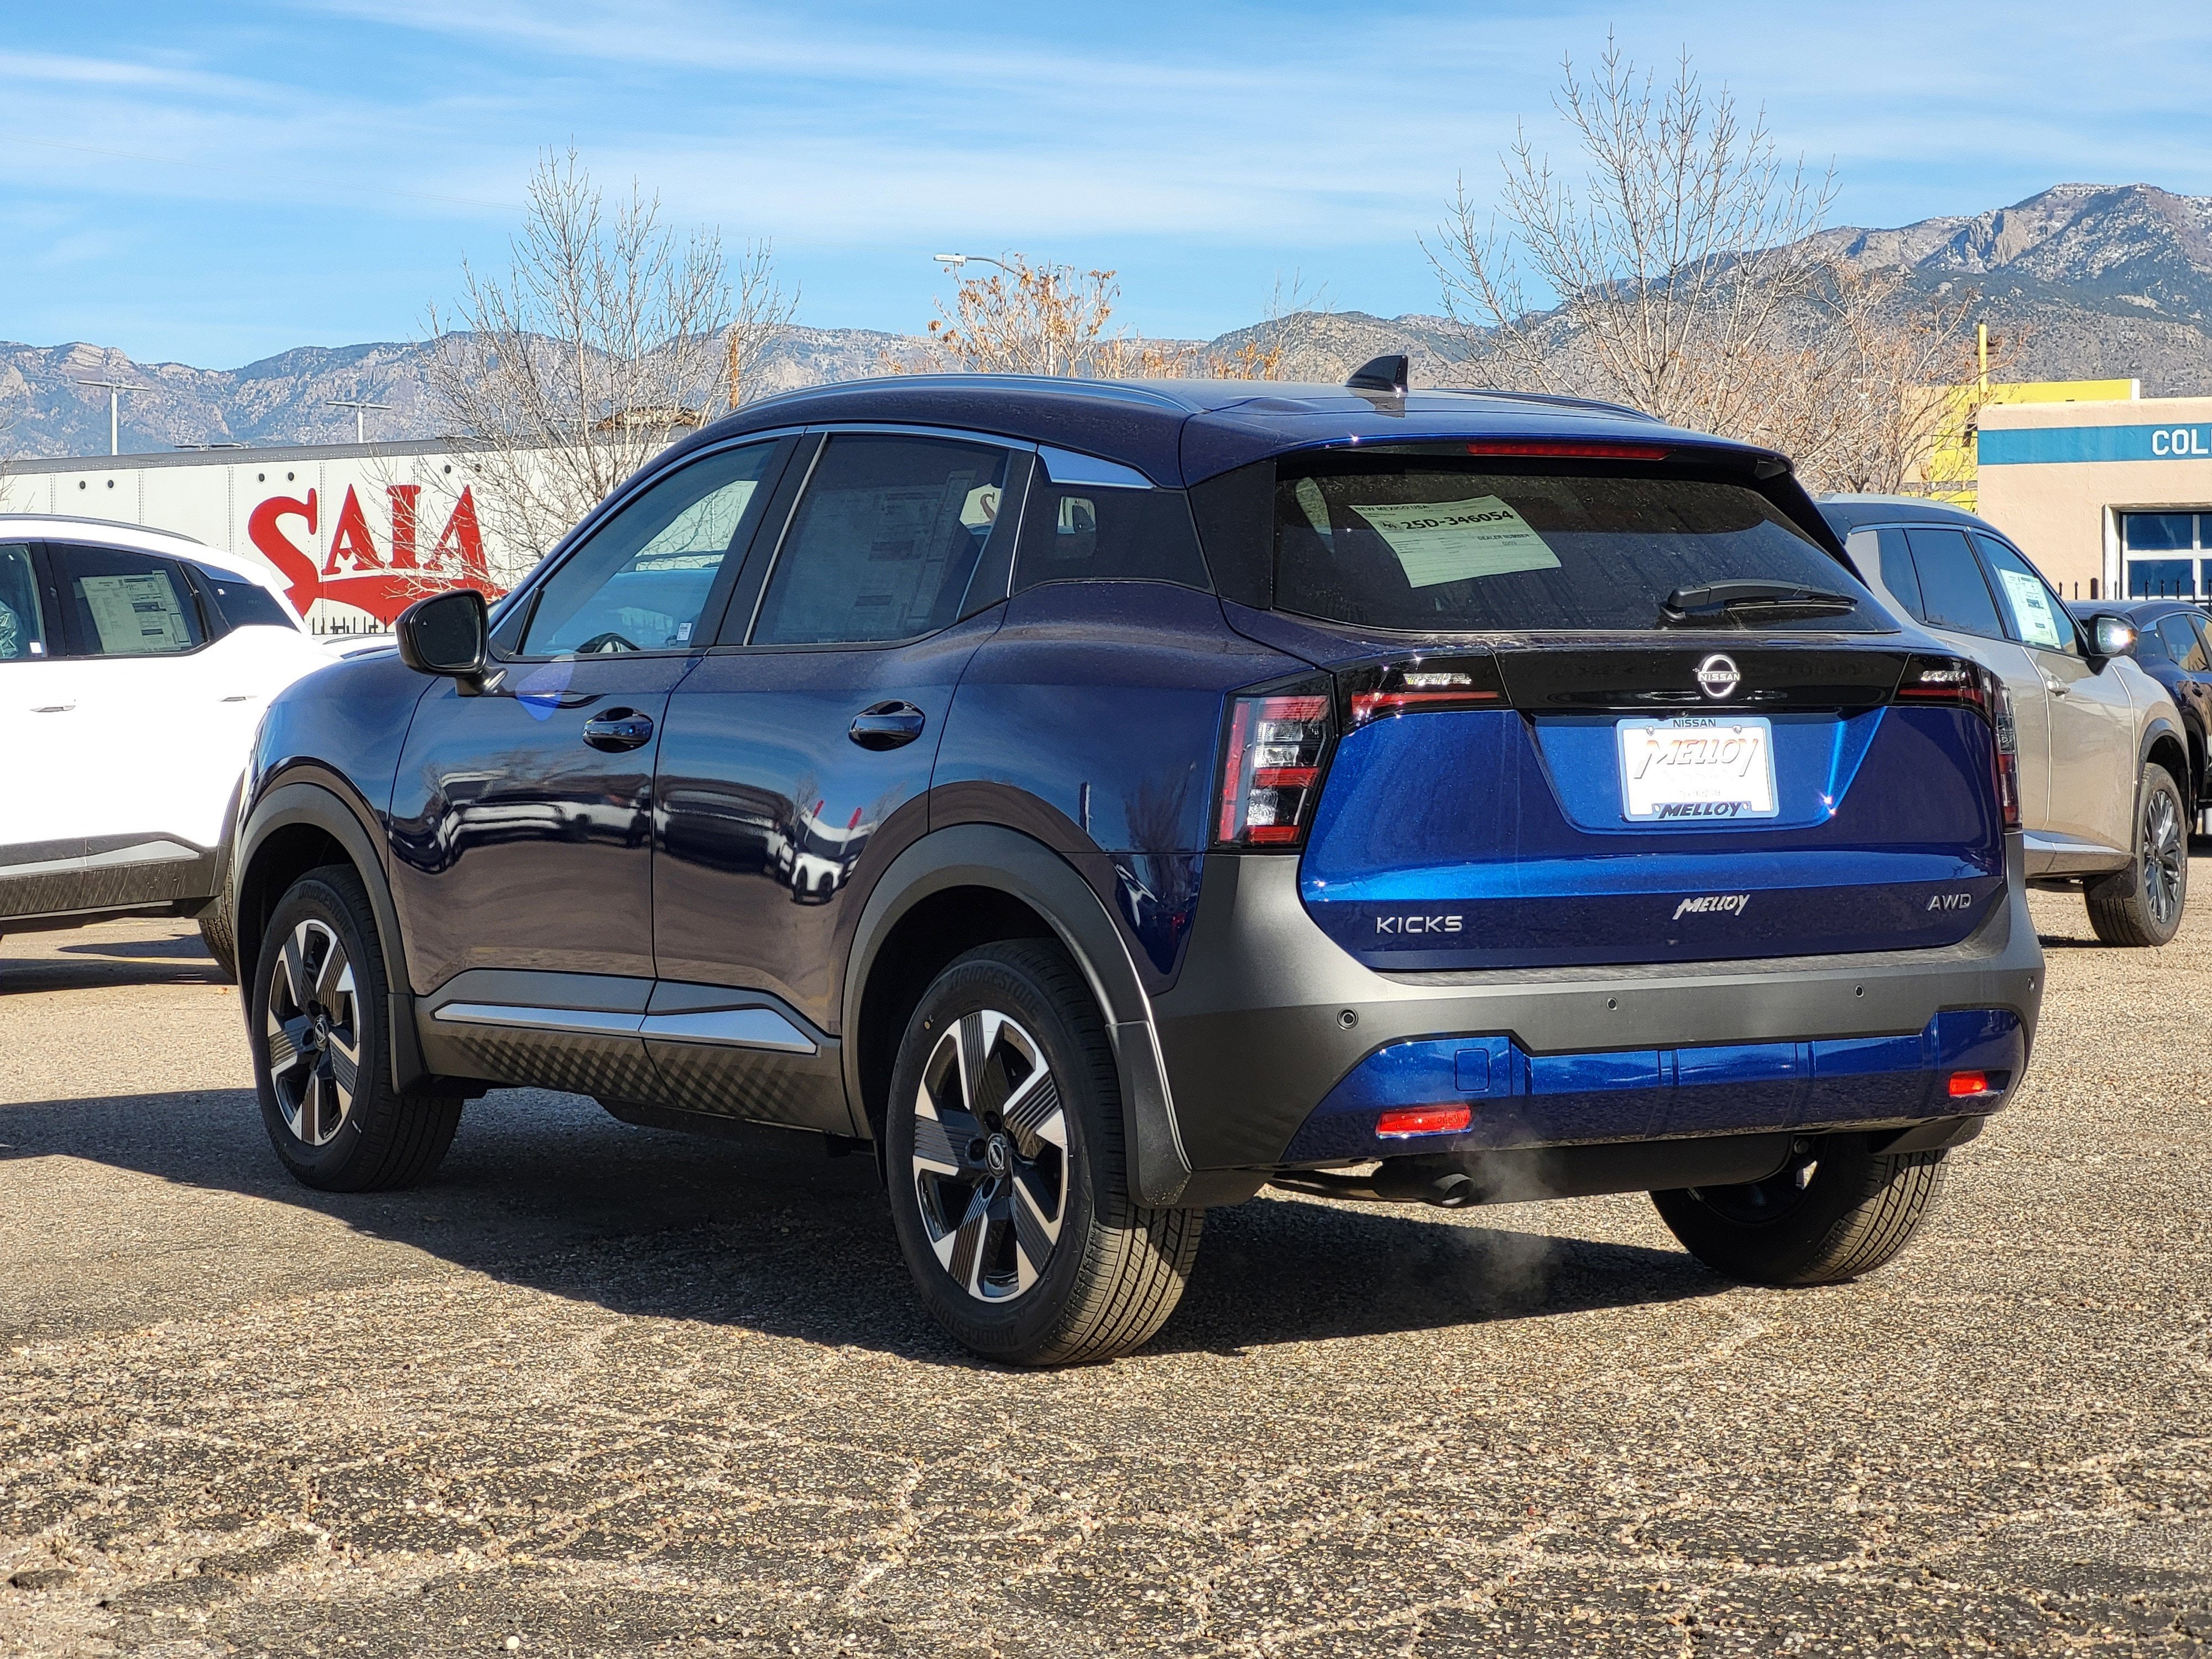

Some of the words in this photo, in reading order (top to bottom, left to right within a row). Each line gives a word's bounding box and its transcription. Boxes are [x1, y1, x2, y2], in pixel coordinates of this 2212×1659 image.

[2152, 429, 2212, 456] COL
[1400, 510, 1514, 530] 25D-346054
[248, 483, 490, 618] SAIA
[1673, 719, 1717, 728] NISSAN
[1634, 739, 1759, 779] MELLOY
[1658, 802, 1742, 819] MELLOY
[1672, 894, 1751, 920] MELLOY
[1926, 893, 1972, 911] AWD
[1376, 916, 1463, 934] KICKS
